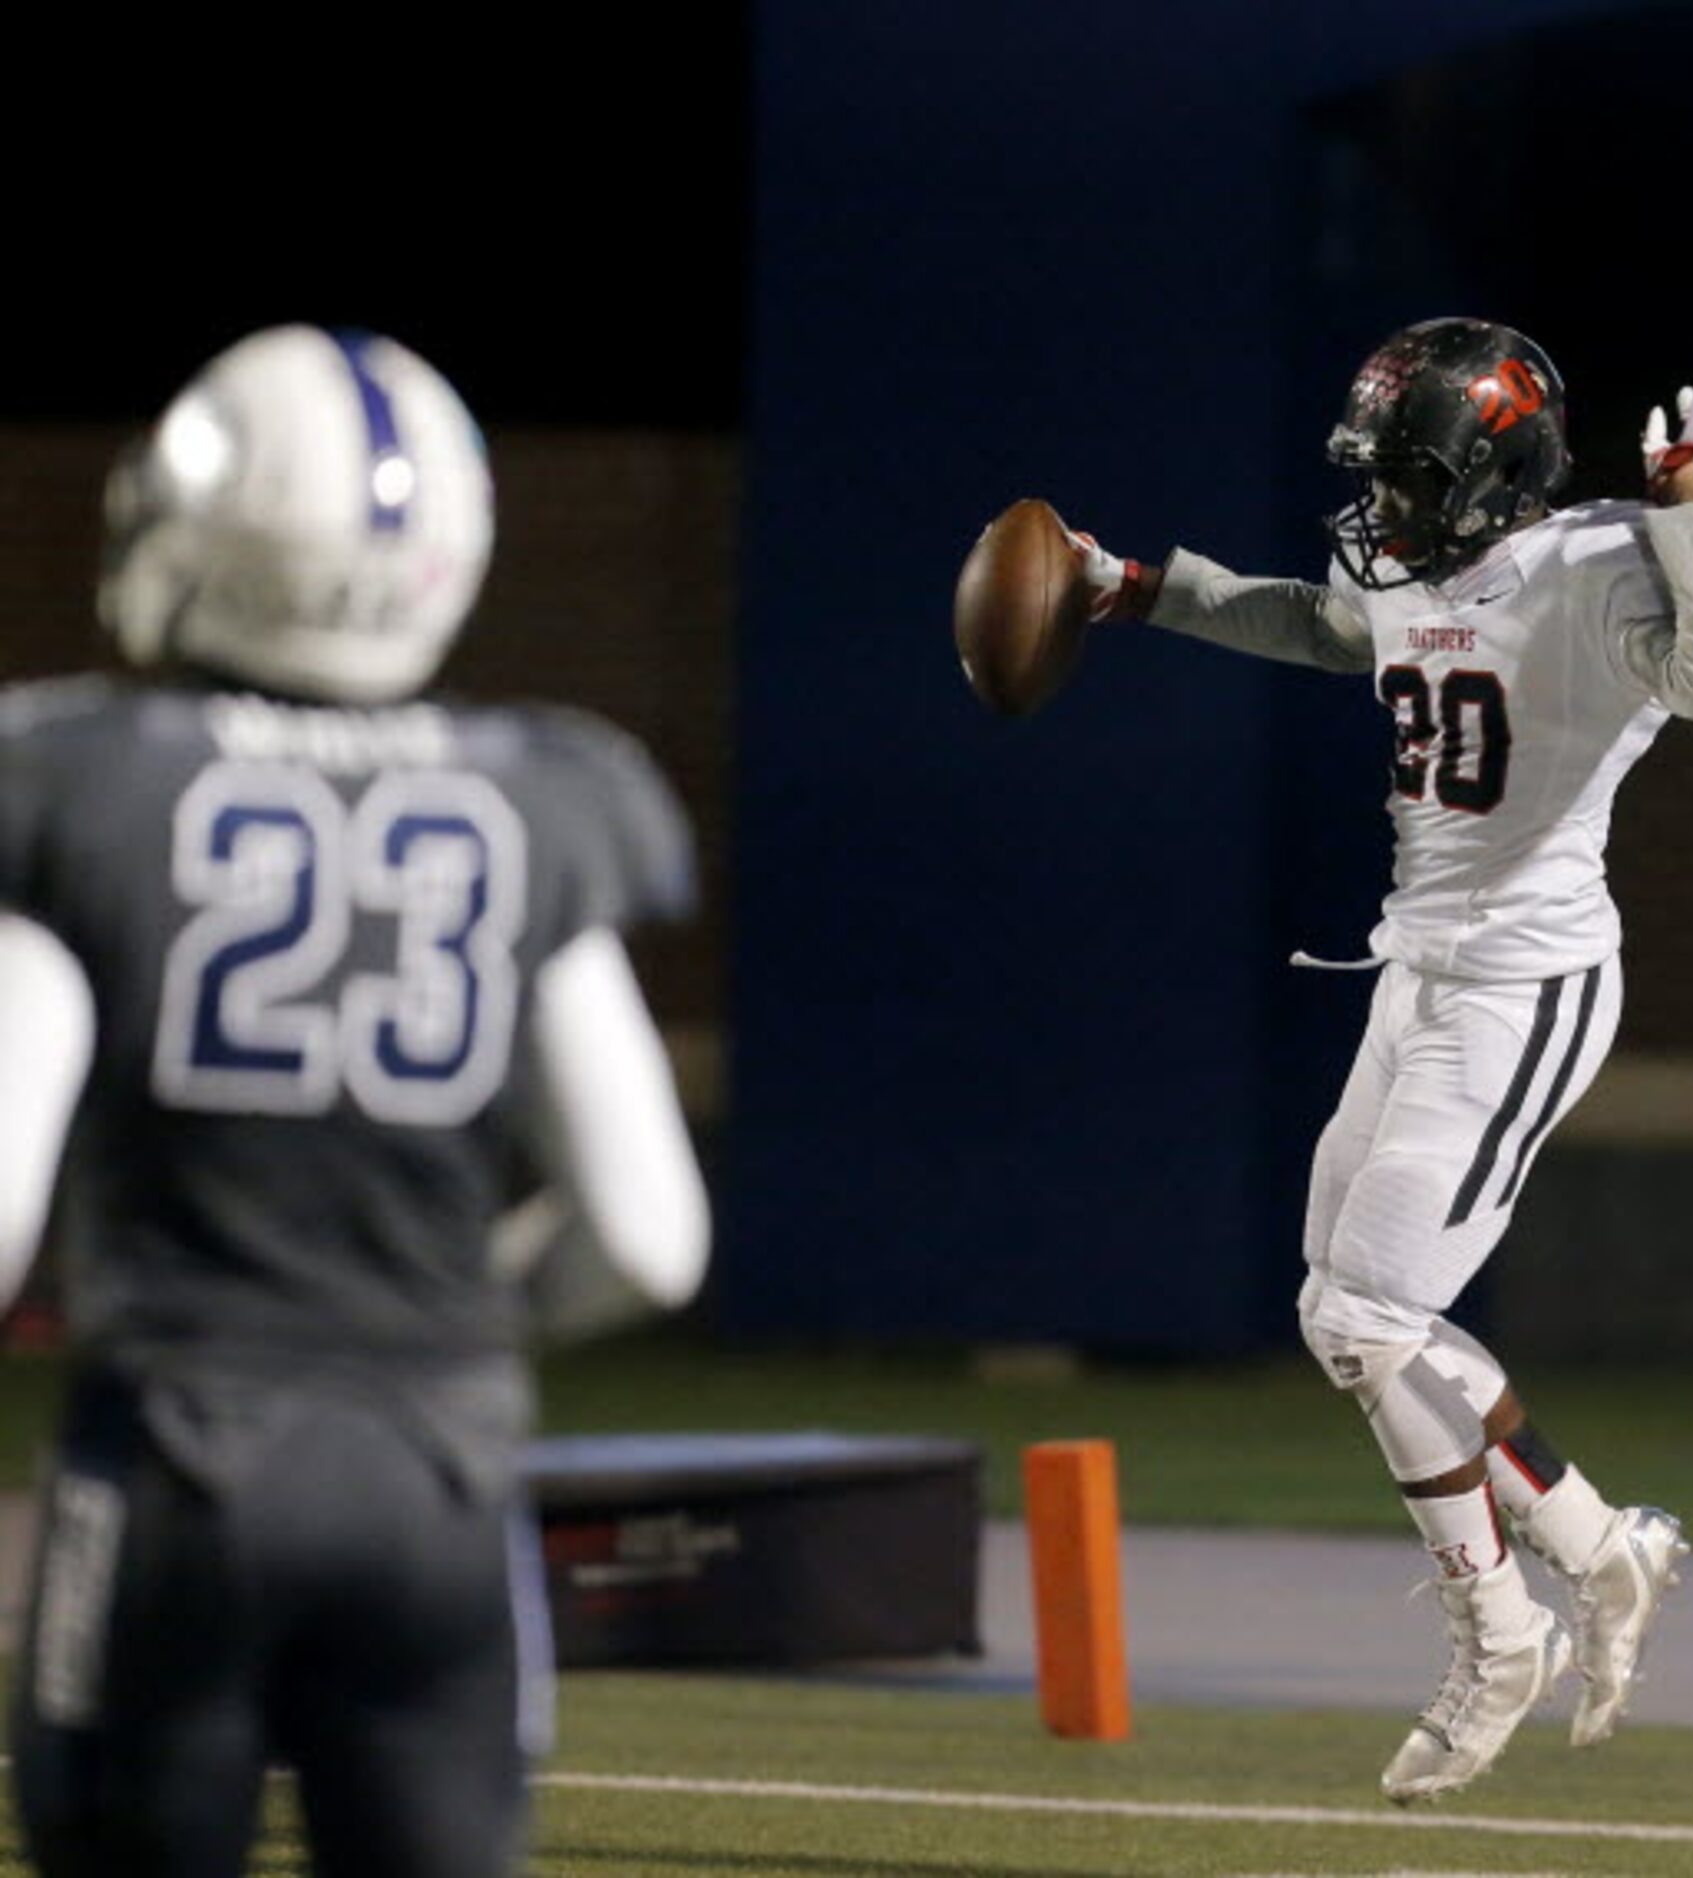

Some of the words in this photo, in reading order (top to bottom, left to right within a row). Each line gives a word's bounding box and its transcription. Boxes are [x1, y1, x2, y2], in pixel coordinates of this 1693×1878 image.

[1466, 358, 1543, 436] 20
[1380, 664, 1512, 816] 20
[152, 758, 528, 1127] 23
